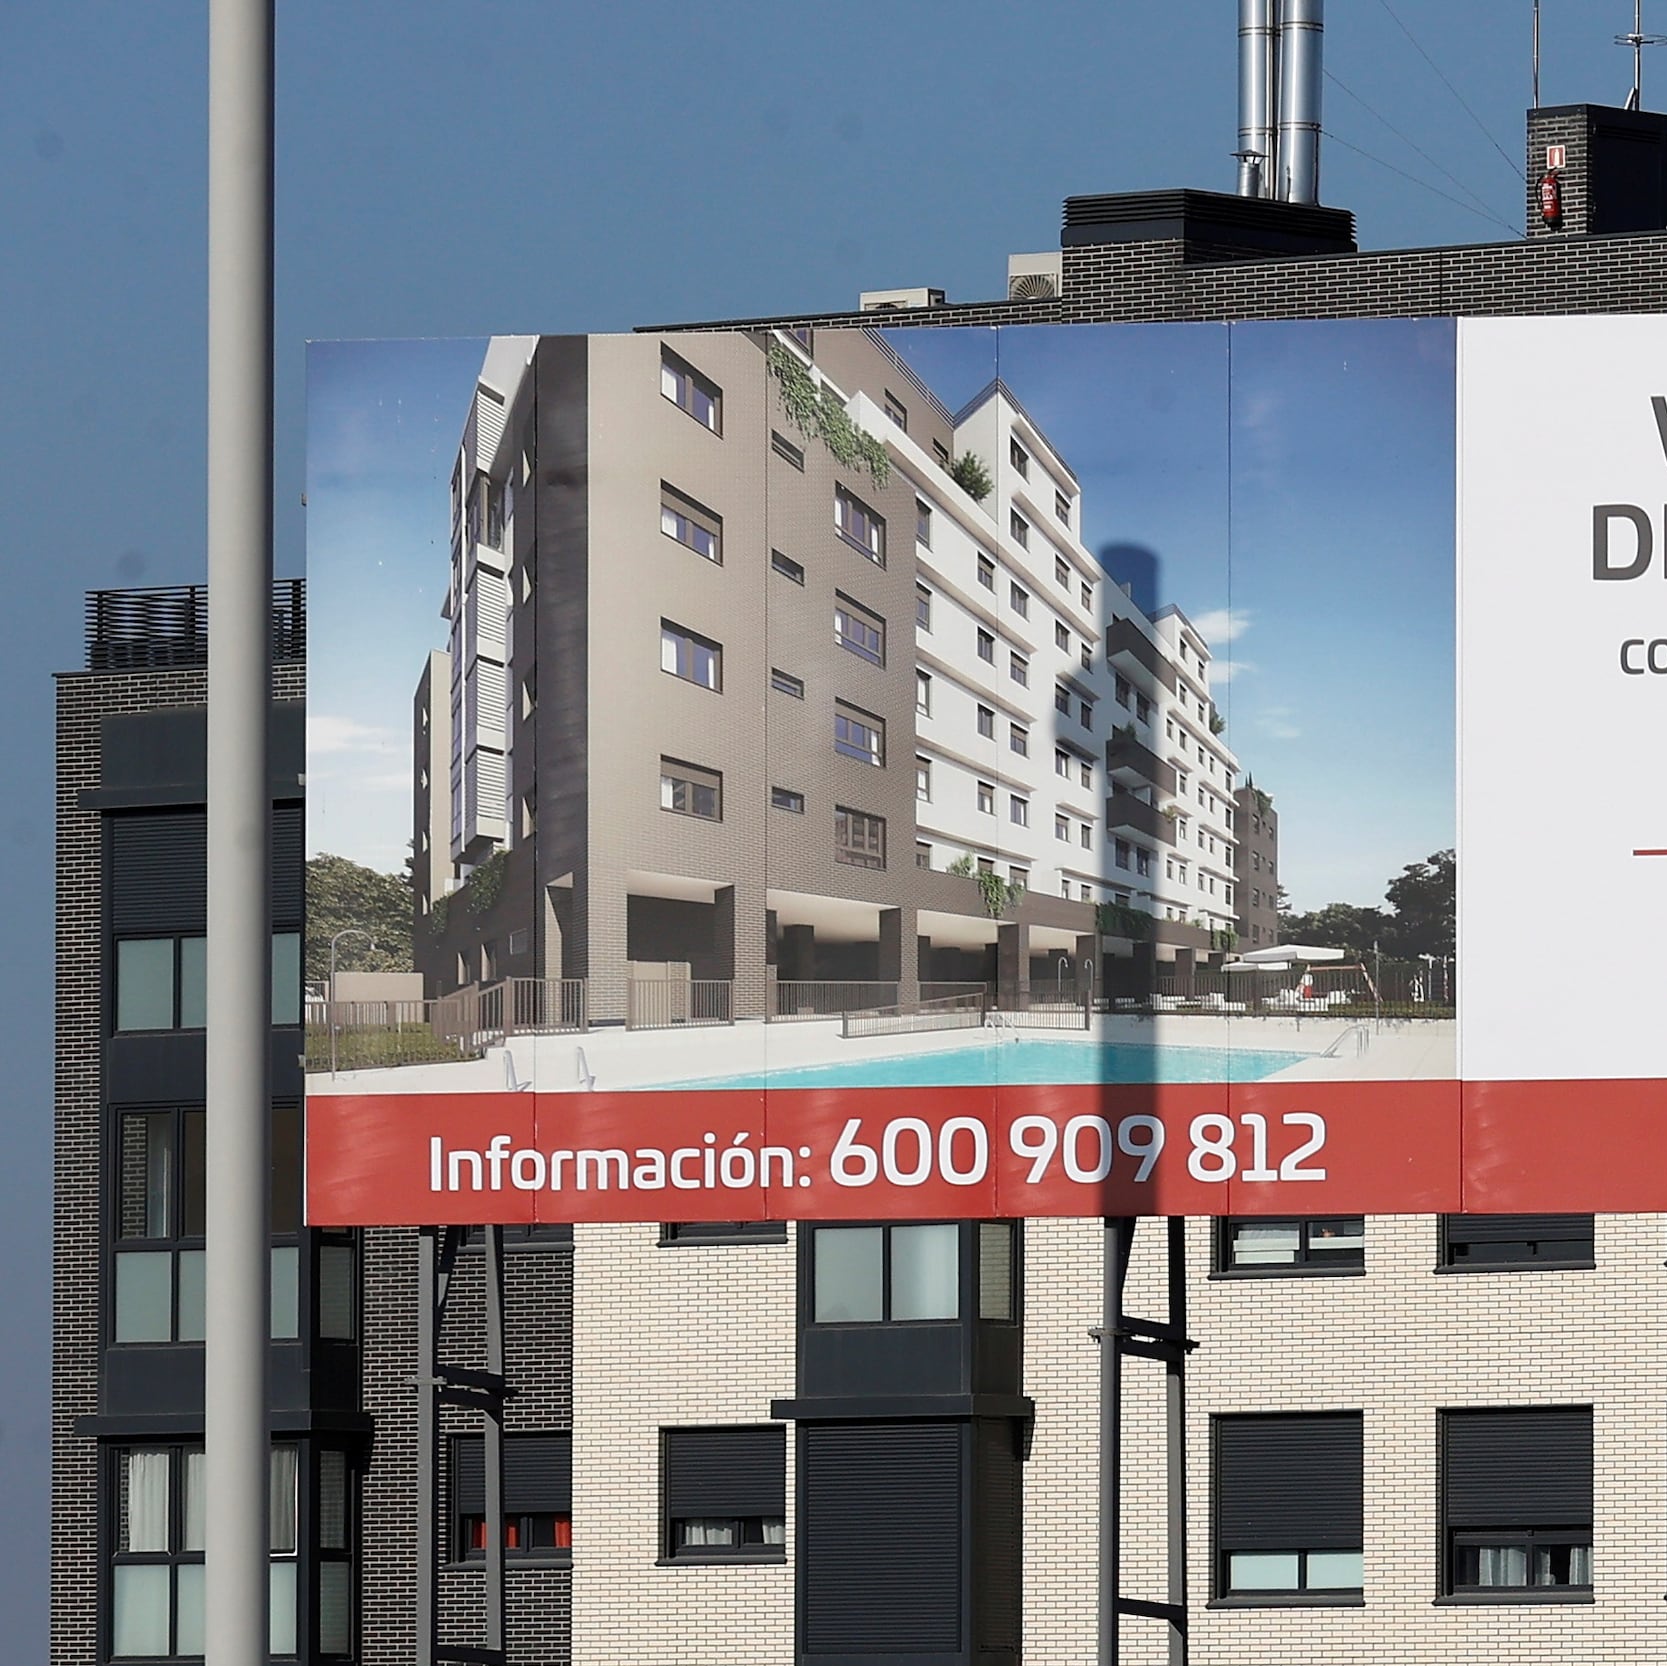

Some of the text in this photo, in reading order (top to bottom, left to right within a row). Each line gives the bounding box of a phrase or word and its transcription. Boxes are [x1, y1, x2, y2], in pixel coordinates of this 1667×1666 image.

[431, 1113, 1325, 1191] Información: 600 909 812
